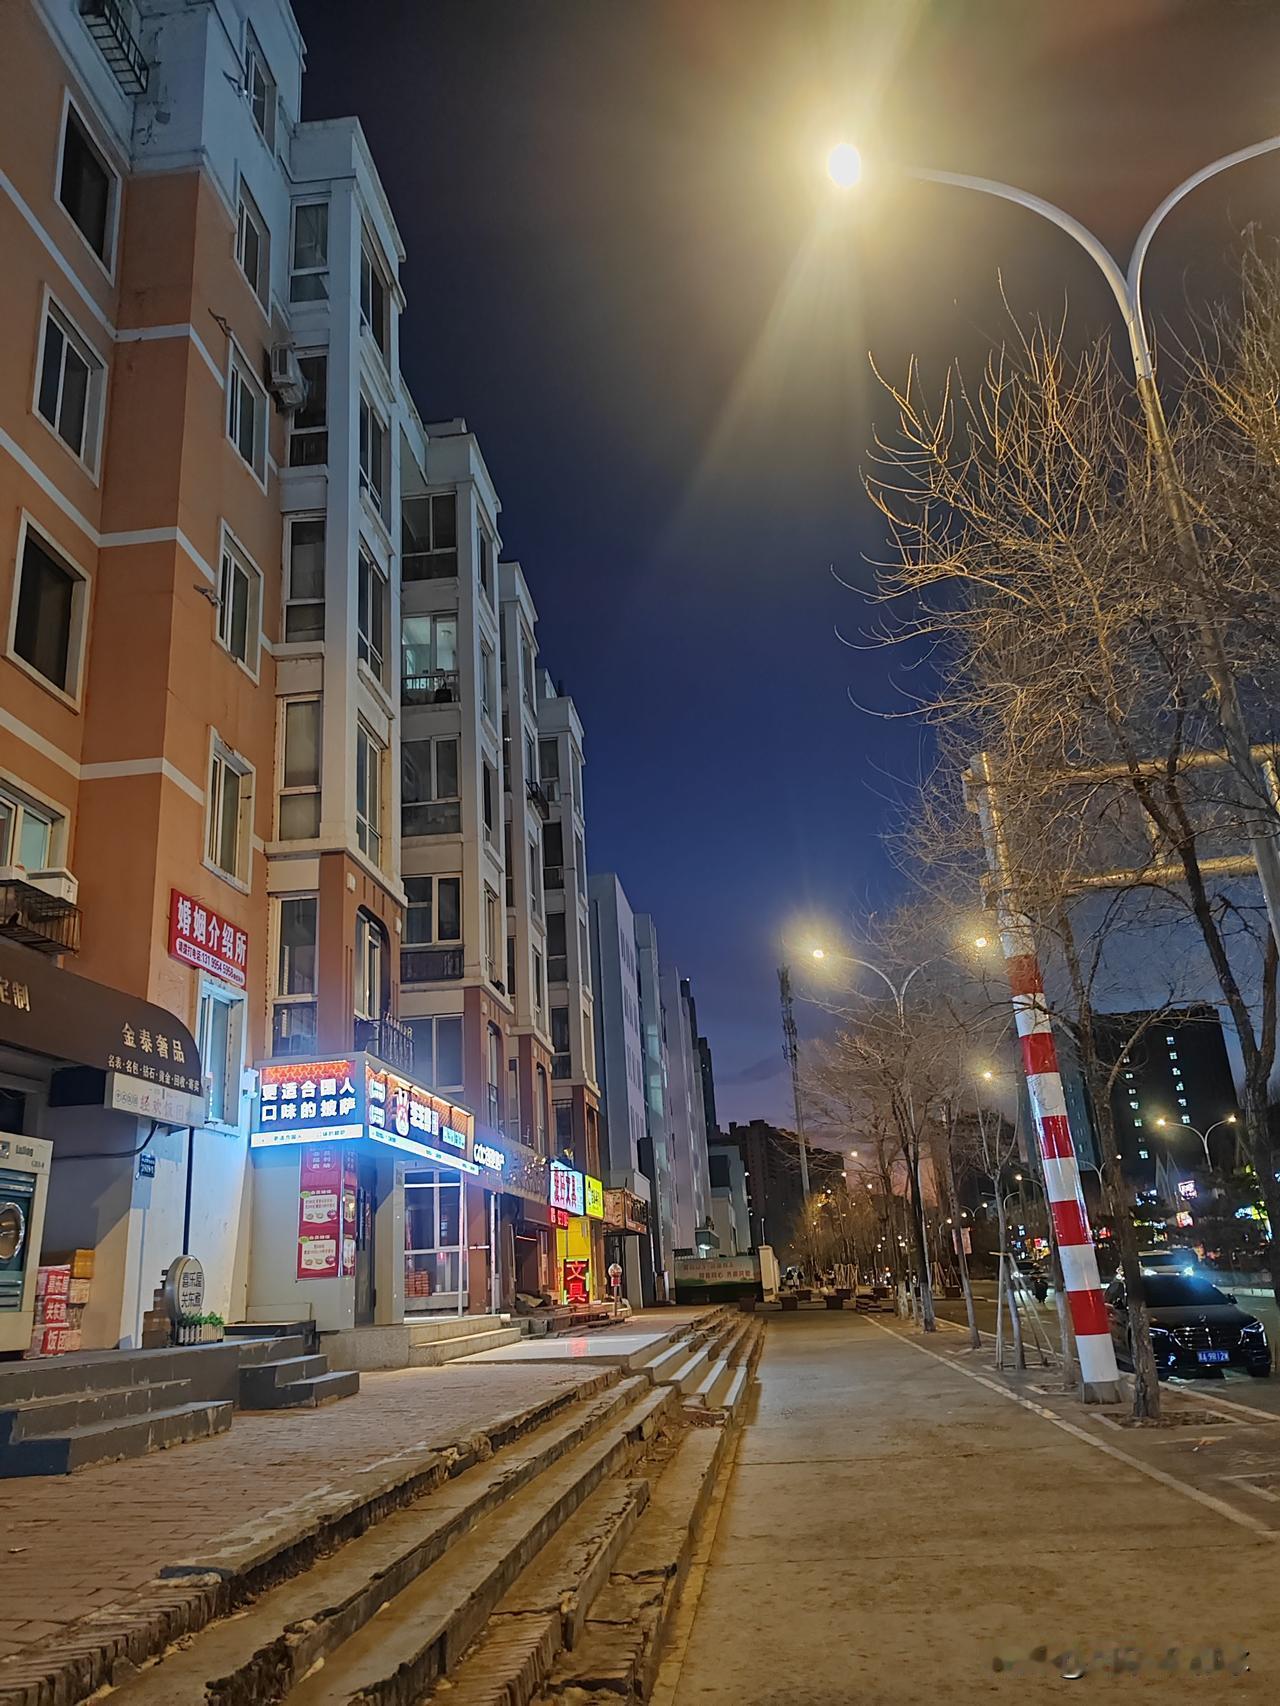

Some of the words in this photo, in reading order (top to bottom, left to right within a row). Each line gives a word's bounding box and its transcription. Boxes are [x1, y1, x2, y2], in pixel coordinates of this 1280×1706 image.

[178, 897, 246, 966] 婚姻介绍所
[122, 1022, 185, 1064] 金泰奢品
[261, 1077, 356, 1102] 更适合国人
[261, 1097, 356, 1122] 口味的披萨
[566, 1261, 586, 1302] 文具
